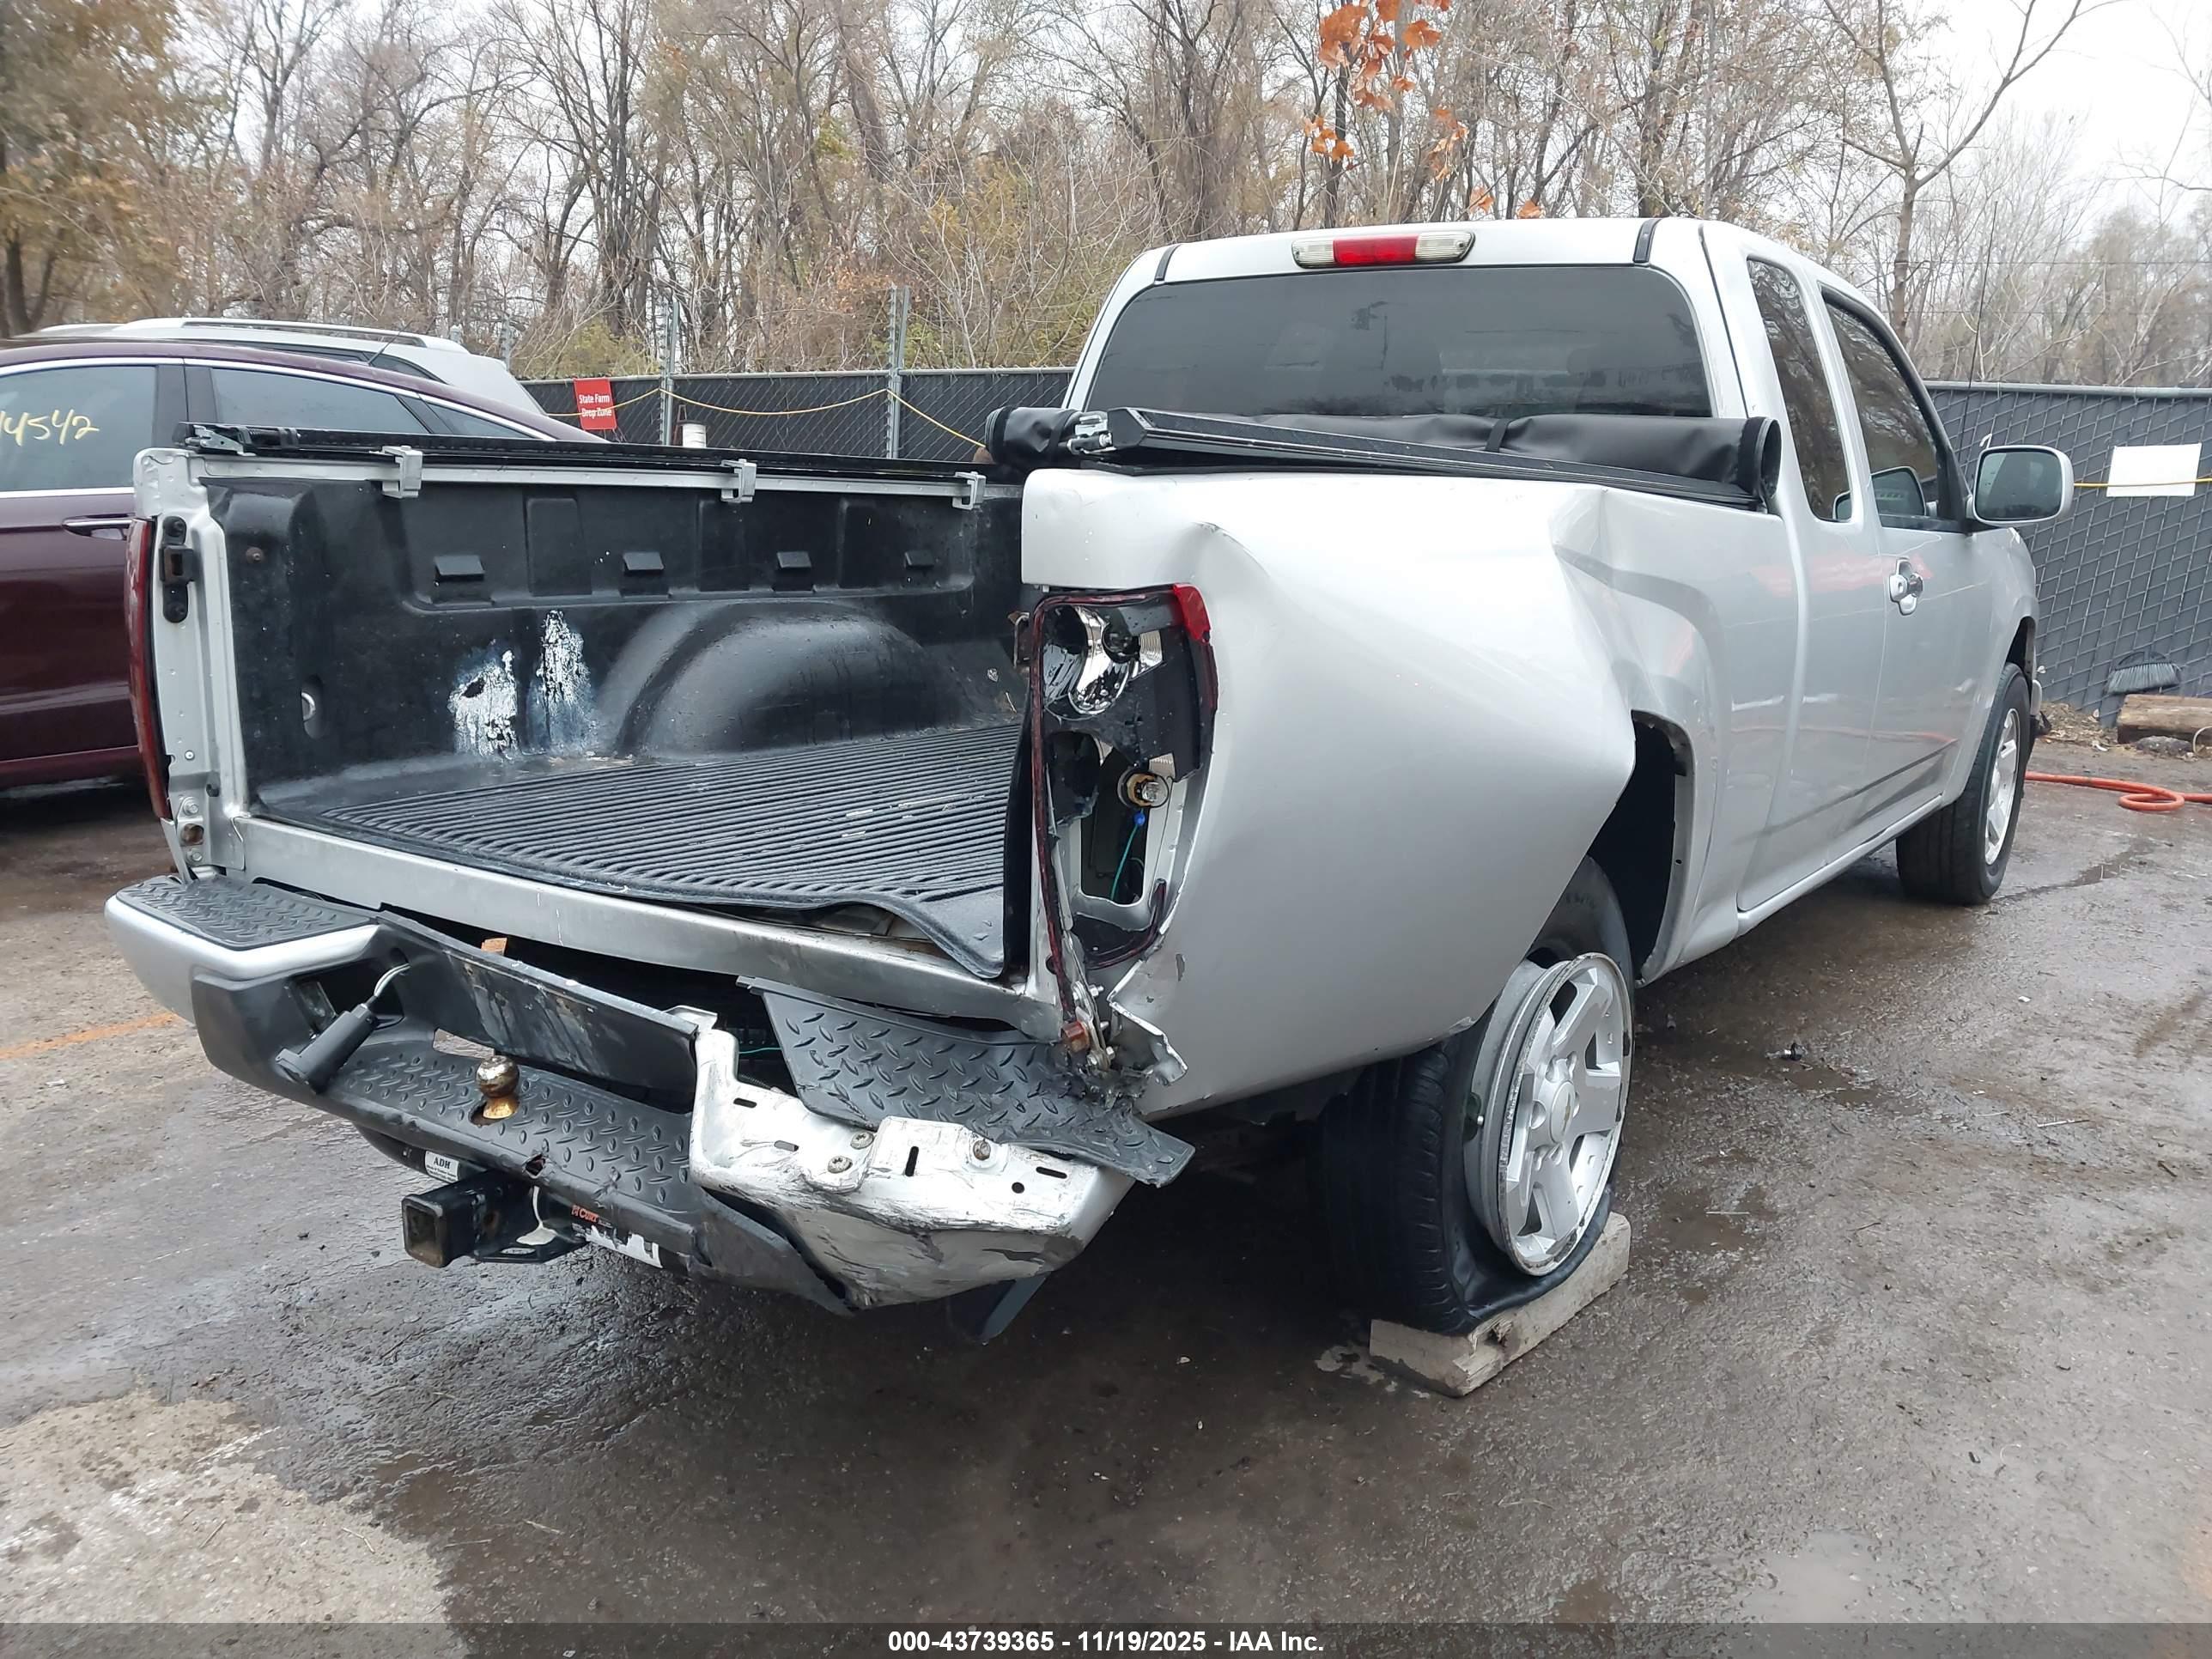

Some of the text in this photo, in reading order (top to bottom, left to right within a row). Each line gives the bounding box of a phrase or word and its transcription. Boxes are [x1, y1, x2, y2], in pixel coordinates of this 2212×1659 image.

[579, 393, 610, 404] State Farm
[581, 408, 596, 419] Drop
[433, 1157, 452, 1170] ADH
